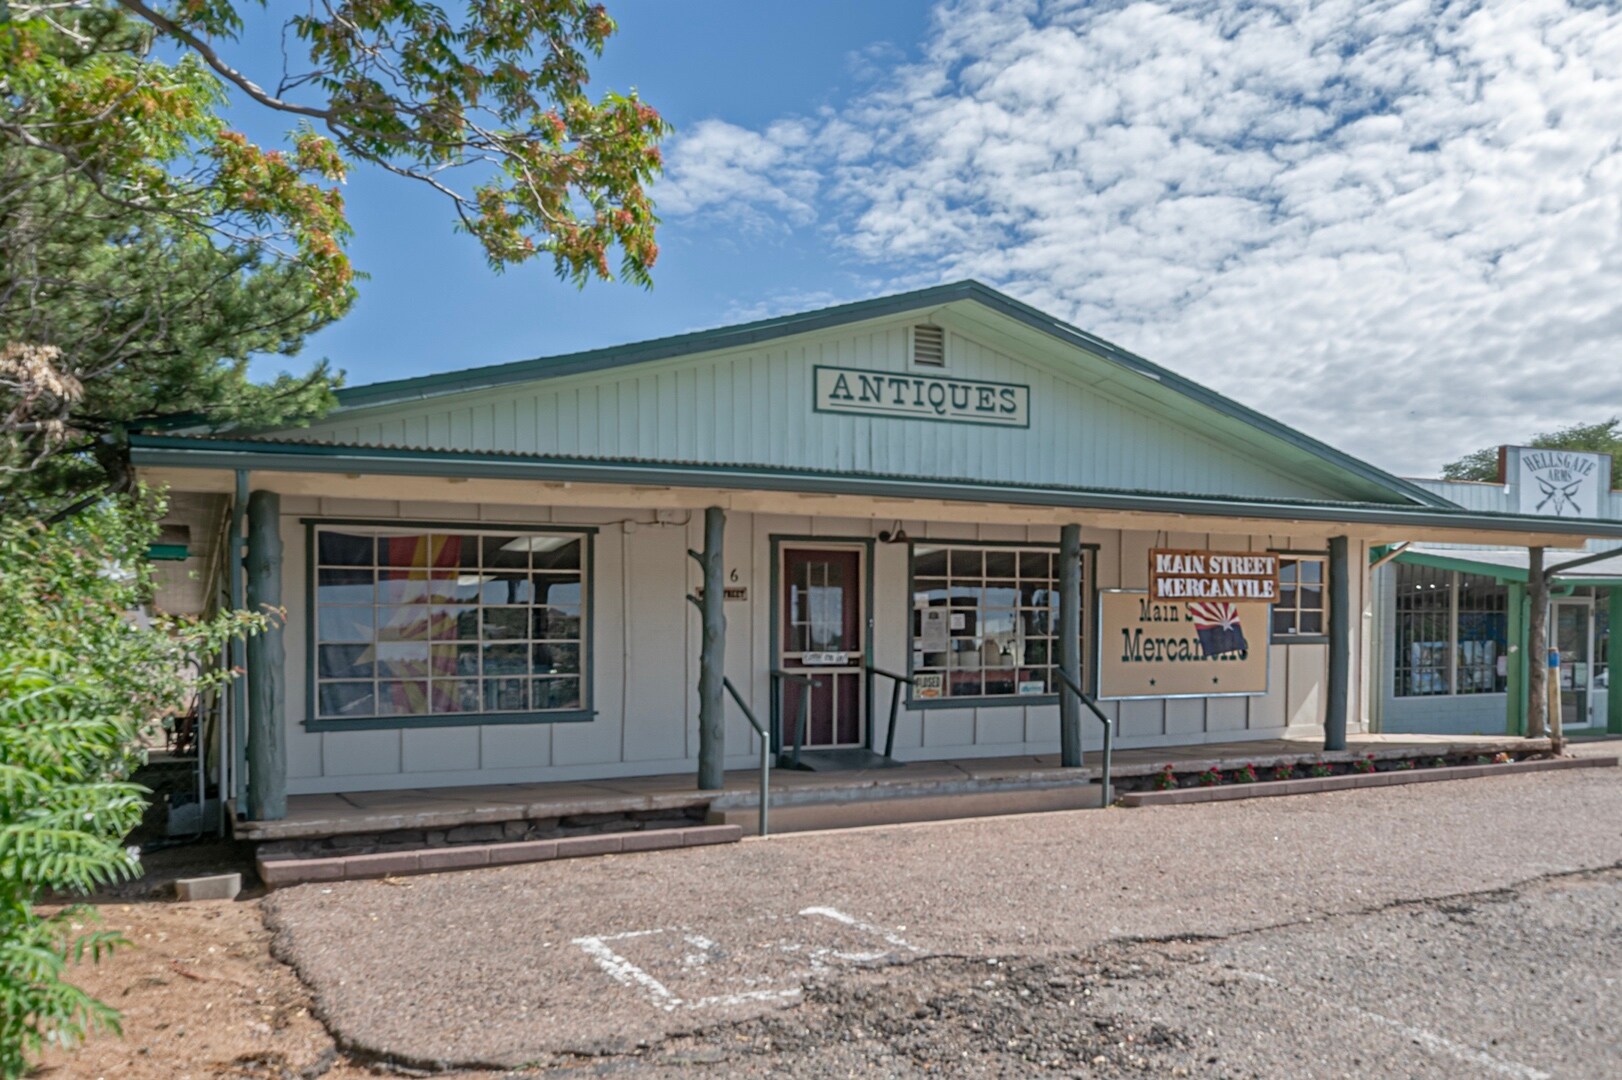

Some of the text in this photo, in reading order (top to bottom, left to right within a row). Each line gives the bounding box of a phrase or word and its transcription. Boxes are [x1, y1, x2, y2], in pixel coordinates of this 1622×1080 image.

[828, 372, 1018, 415] ANTIQUES
[1522, 451, 1597, 477] HELLSGATE
[730, 567, 739, 583] 6
[1155, 553, 1276, 576] MAIN STREET
[1156, 577, 1275, 598] MERCANTILE
